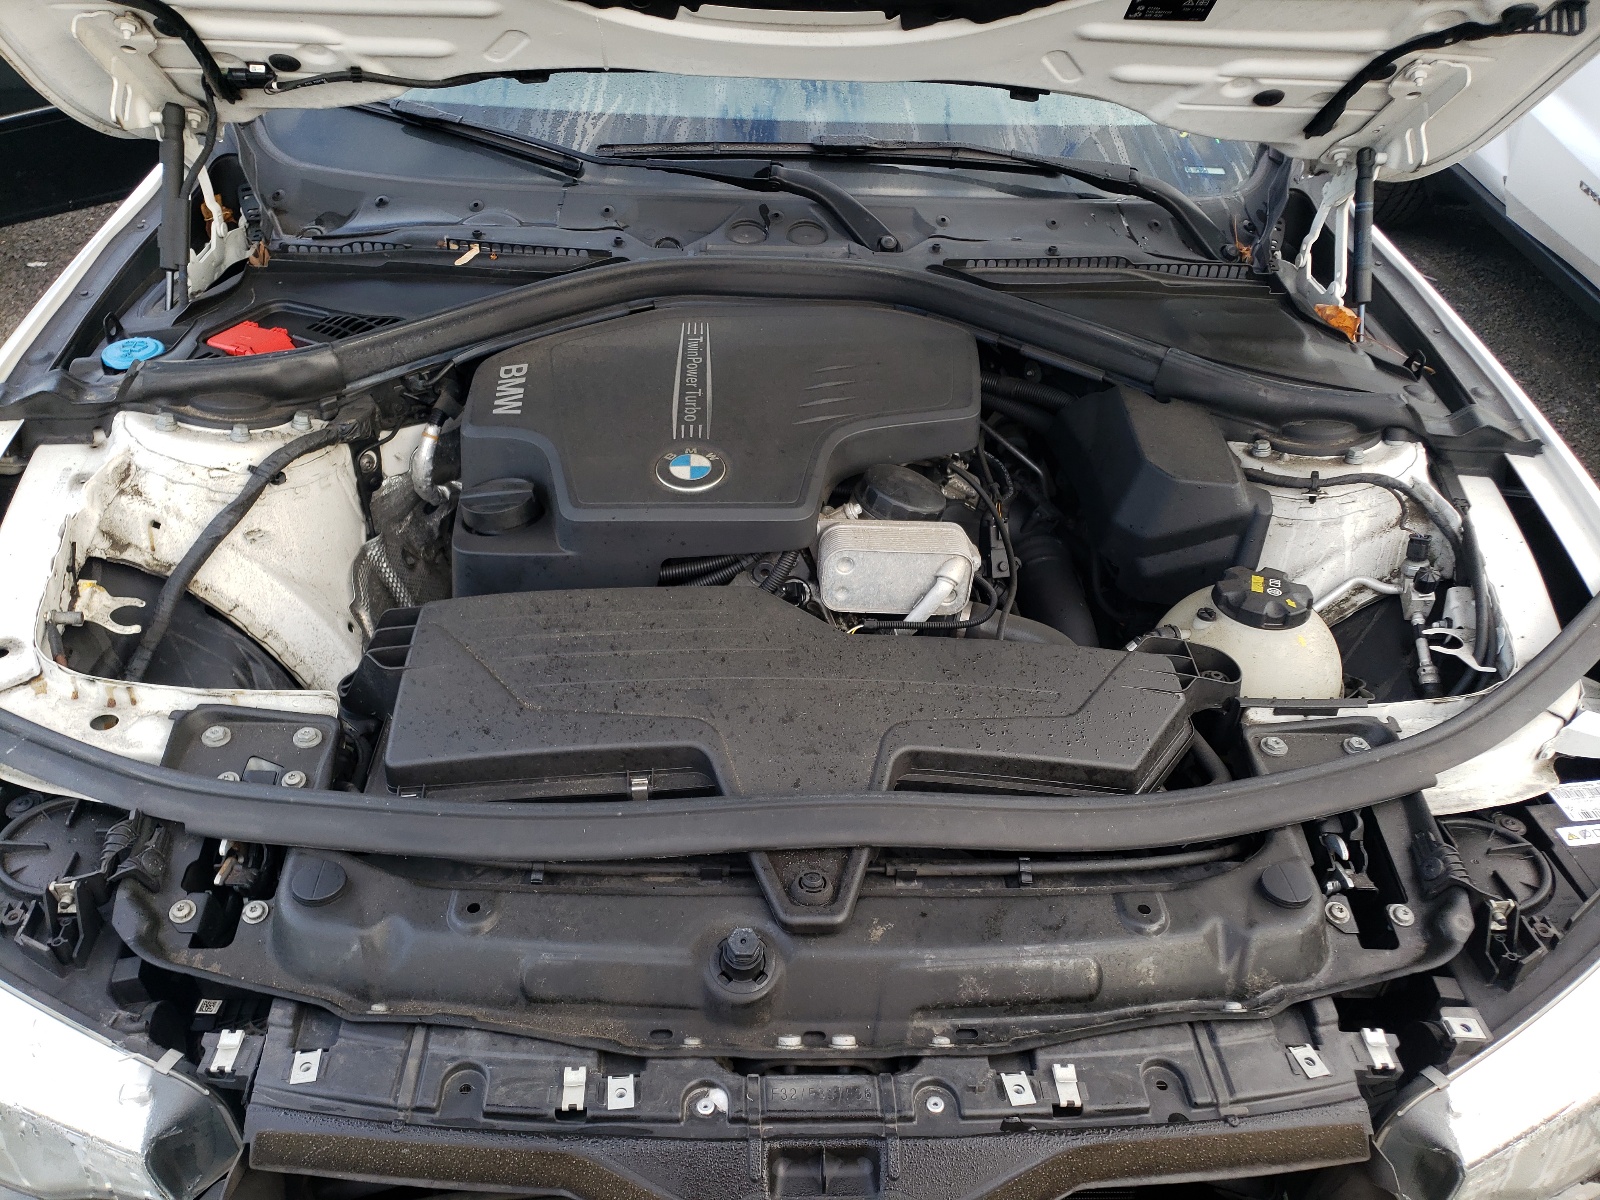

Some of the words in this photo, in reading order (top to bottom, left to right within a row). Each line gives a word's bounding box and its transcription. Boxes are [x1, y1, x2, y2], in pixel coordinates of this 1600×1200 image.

[685, 336, 704, 388] TwinPower
[492, 363, 529, 415] BMW
[683, 388, 702, 422] Turbo
[663, 447, 720, 461] BMW
